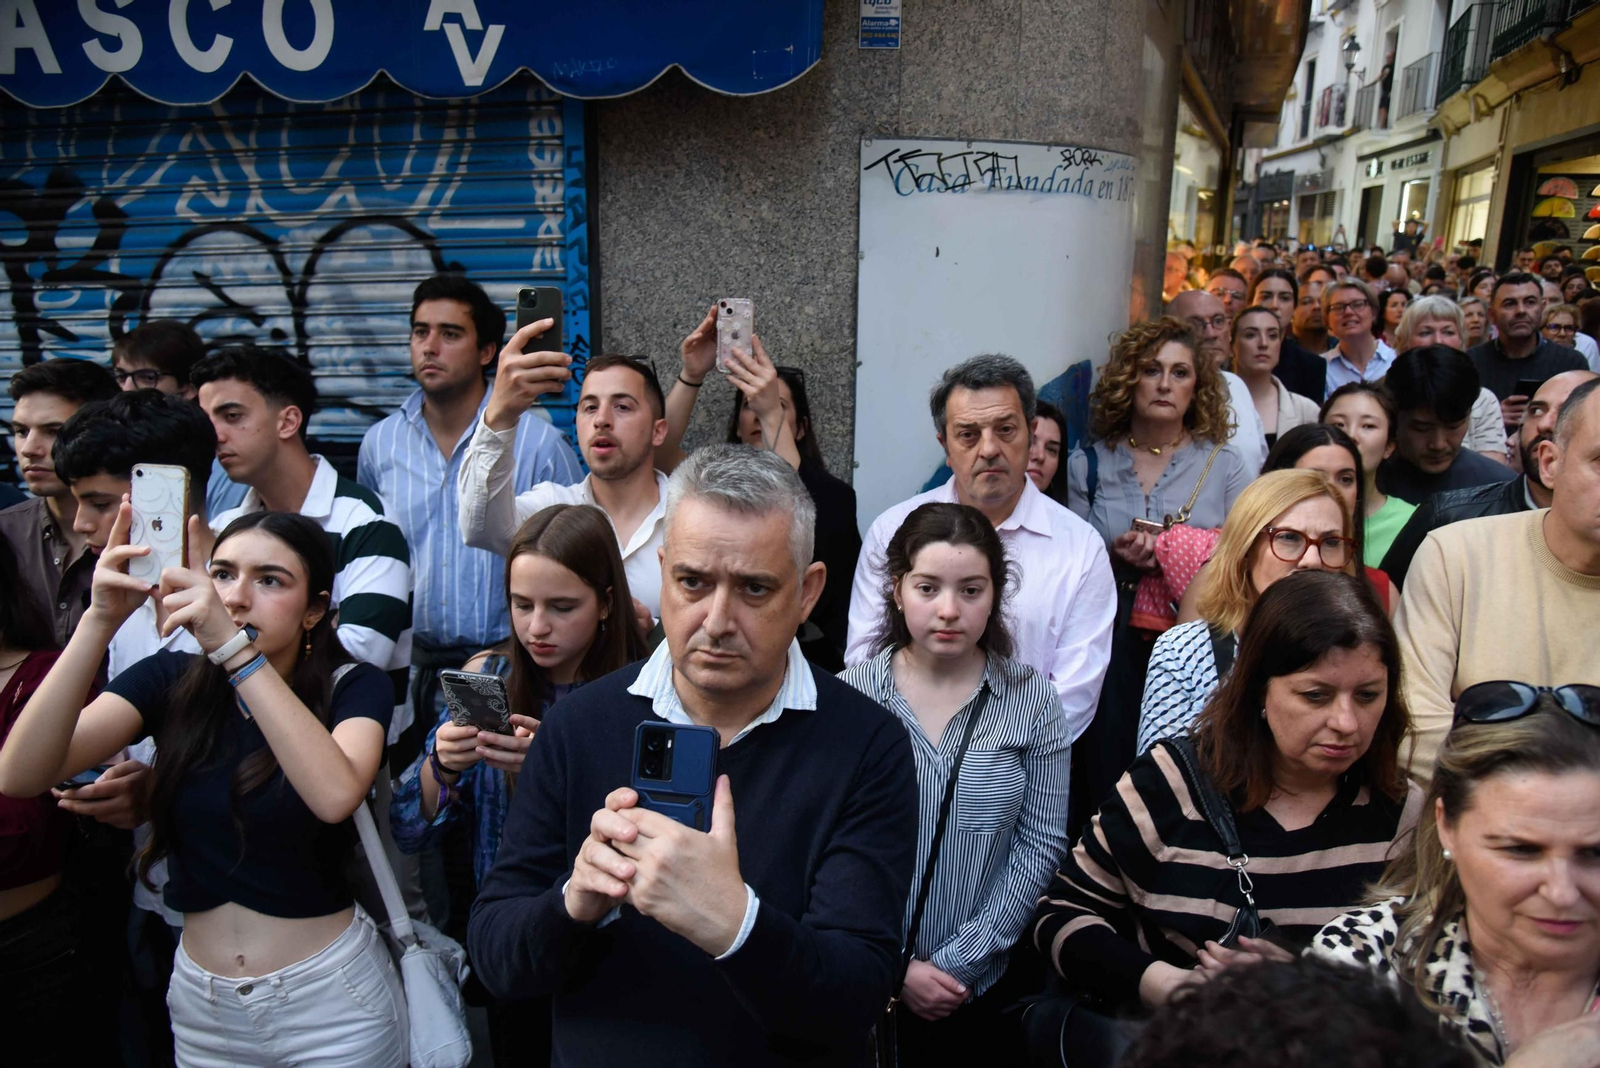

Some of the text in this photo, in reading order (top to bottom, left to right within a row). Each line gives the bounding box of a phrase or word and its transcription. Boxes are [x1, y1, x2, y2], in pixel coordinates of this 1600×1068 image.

[894, 163, 970, 197] Casa
[986, 164, 1093, 197] Fundada
[1098, 181, 1113, 200] en
